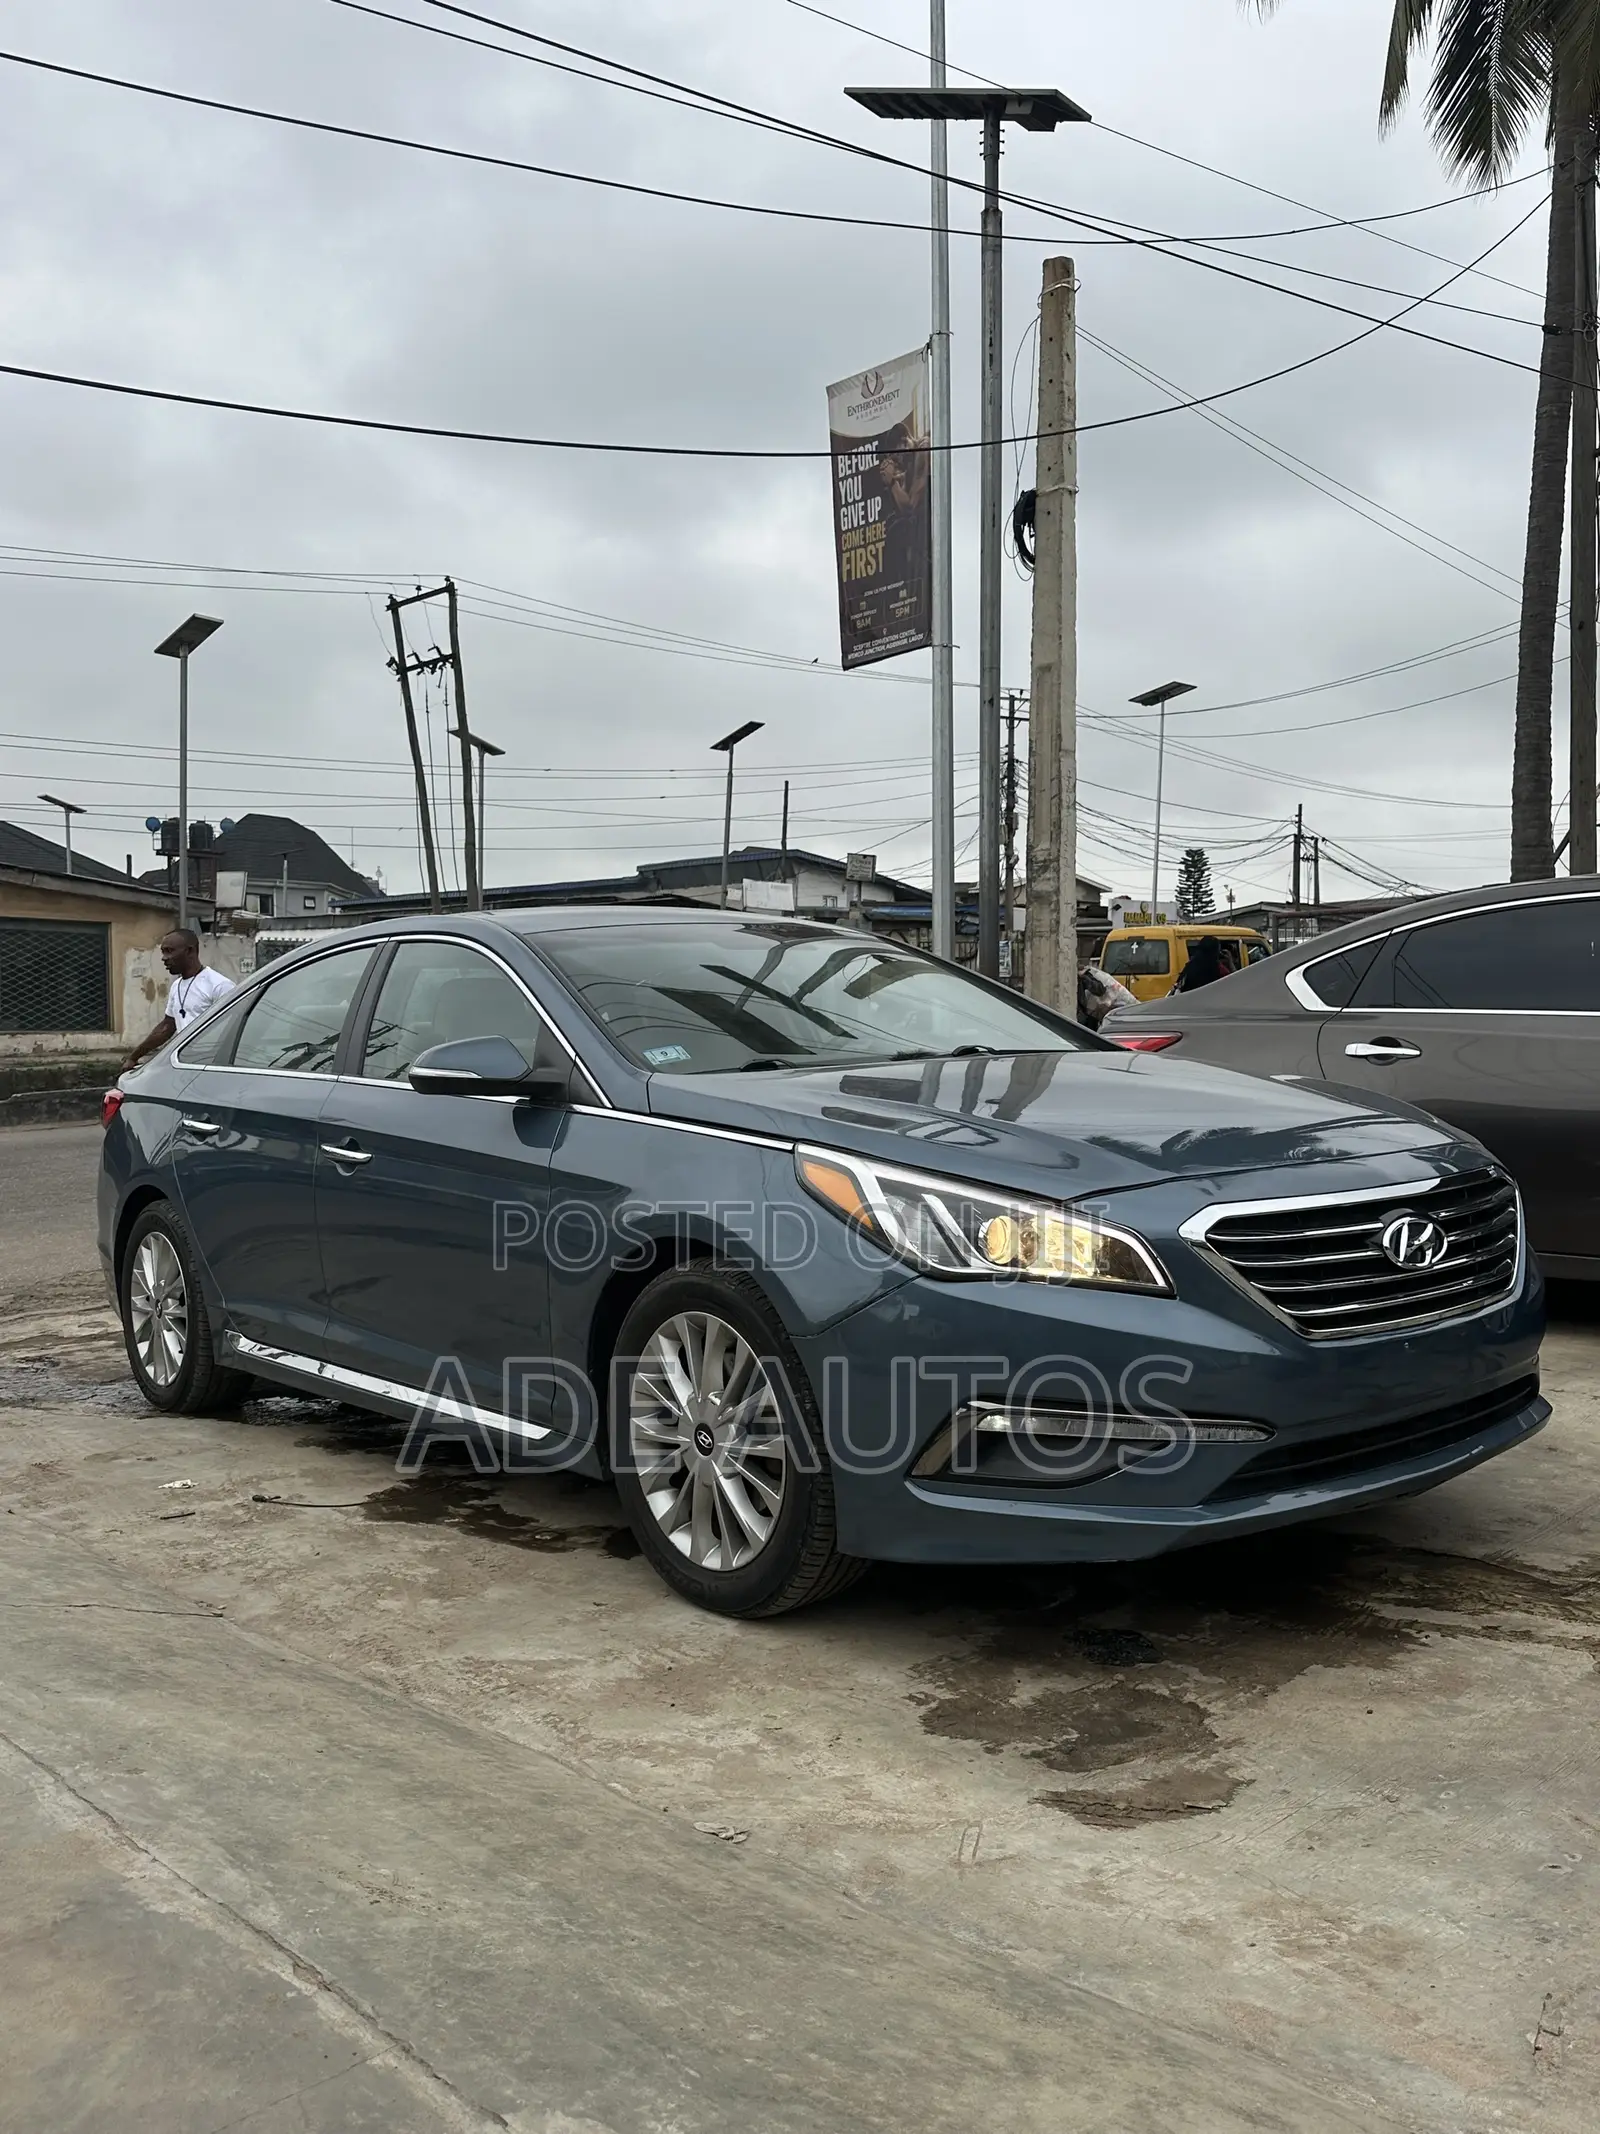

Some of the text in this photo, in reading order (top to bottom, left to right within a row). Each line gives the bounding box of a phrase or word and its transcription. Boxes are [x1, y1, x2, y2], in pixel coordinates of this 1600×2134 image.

[847, 389, 900, 417] ENTHRONEMENT
[837, 440, 880, 478] BEFORE
[839, 475, 862, 505] YOU
[840, 495, 882, 531] GIVE UP
[841, 521, 887, 551] COME HERE
[842, 541, 885, 582] FIRST
[895, 605, 910, 618] 5PM
